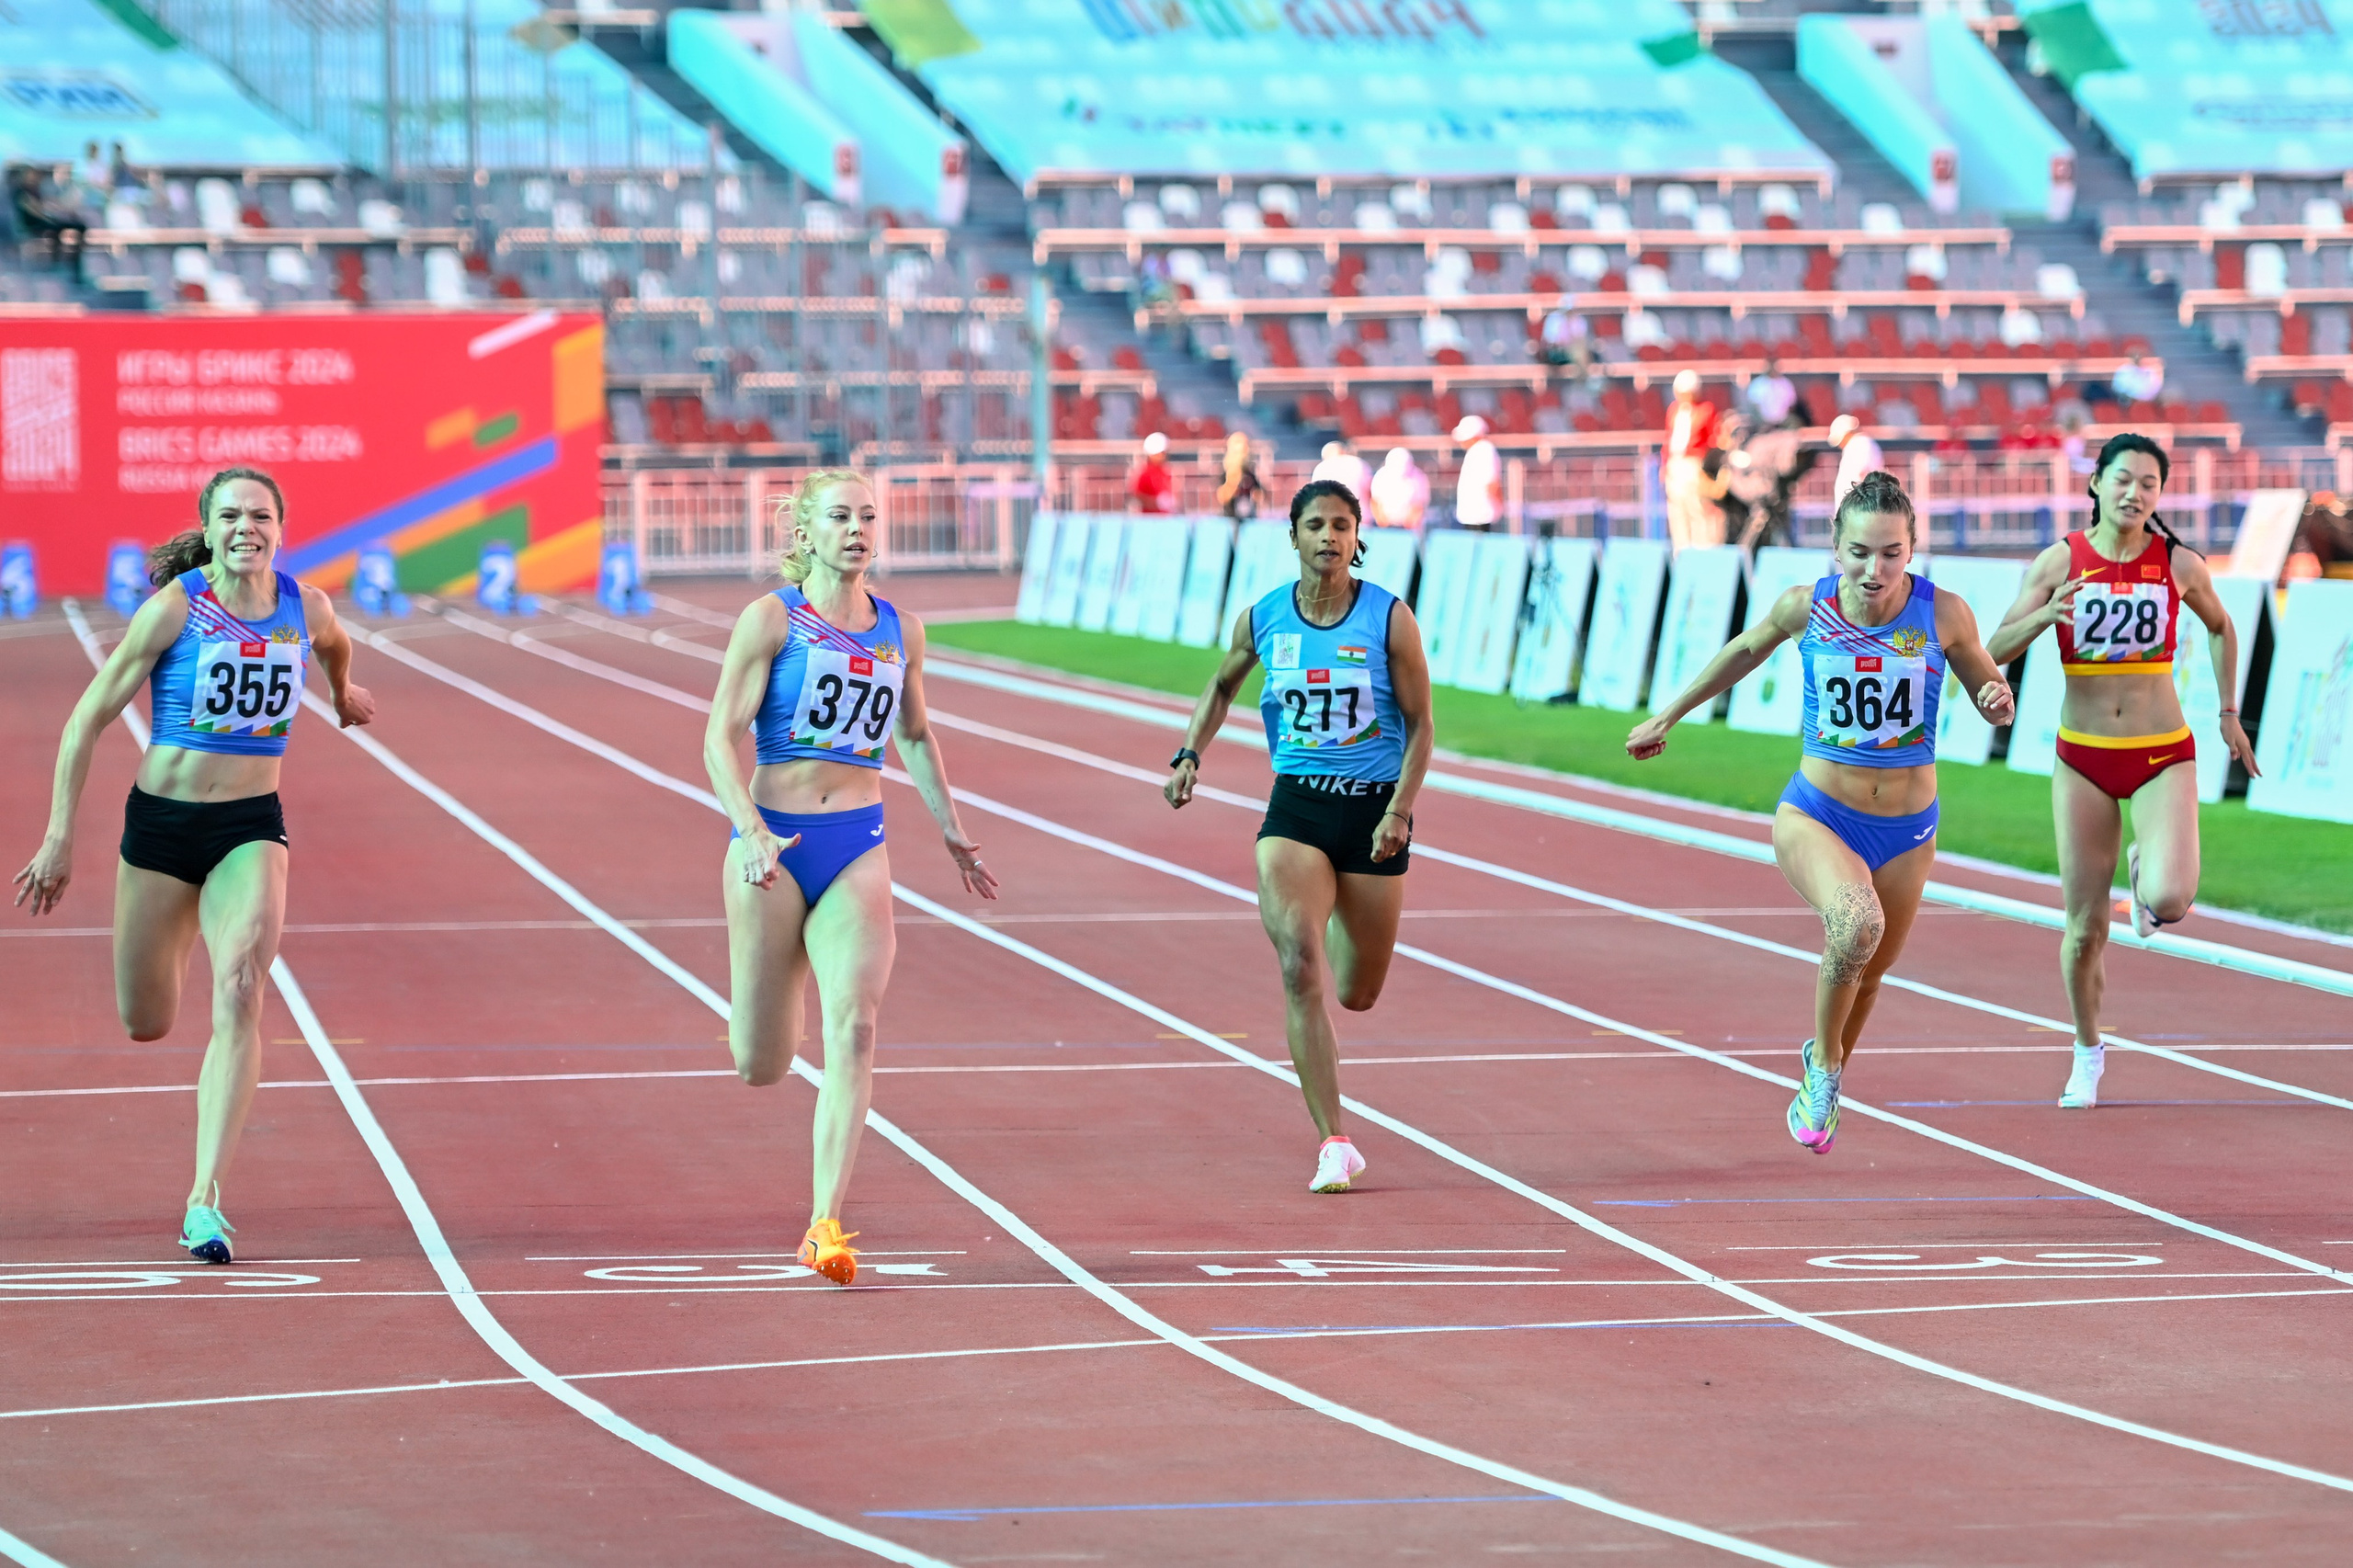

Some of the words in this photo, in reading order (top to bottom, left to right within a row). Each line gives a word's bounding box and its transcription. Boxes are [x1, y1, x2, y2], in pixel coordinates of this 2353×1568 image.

[287, 348, 355, 384] 2024
[119, 426, 196, 461] BRICS
[199, 426, 293, 461] GAMES
[294, 426, 363, 460] 2024
[480, 553, 515, 605] 2
[2085, 599, 2158, 644] 228
[206, 662, 292, 719] 355
[809, 674, 894, 741] 379
[1285, 687, 1359, 733] 277
[1826, 676, 1913, 732] 364
[1298, 775, 1370, 796] NIKE
